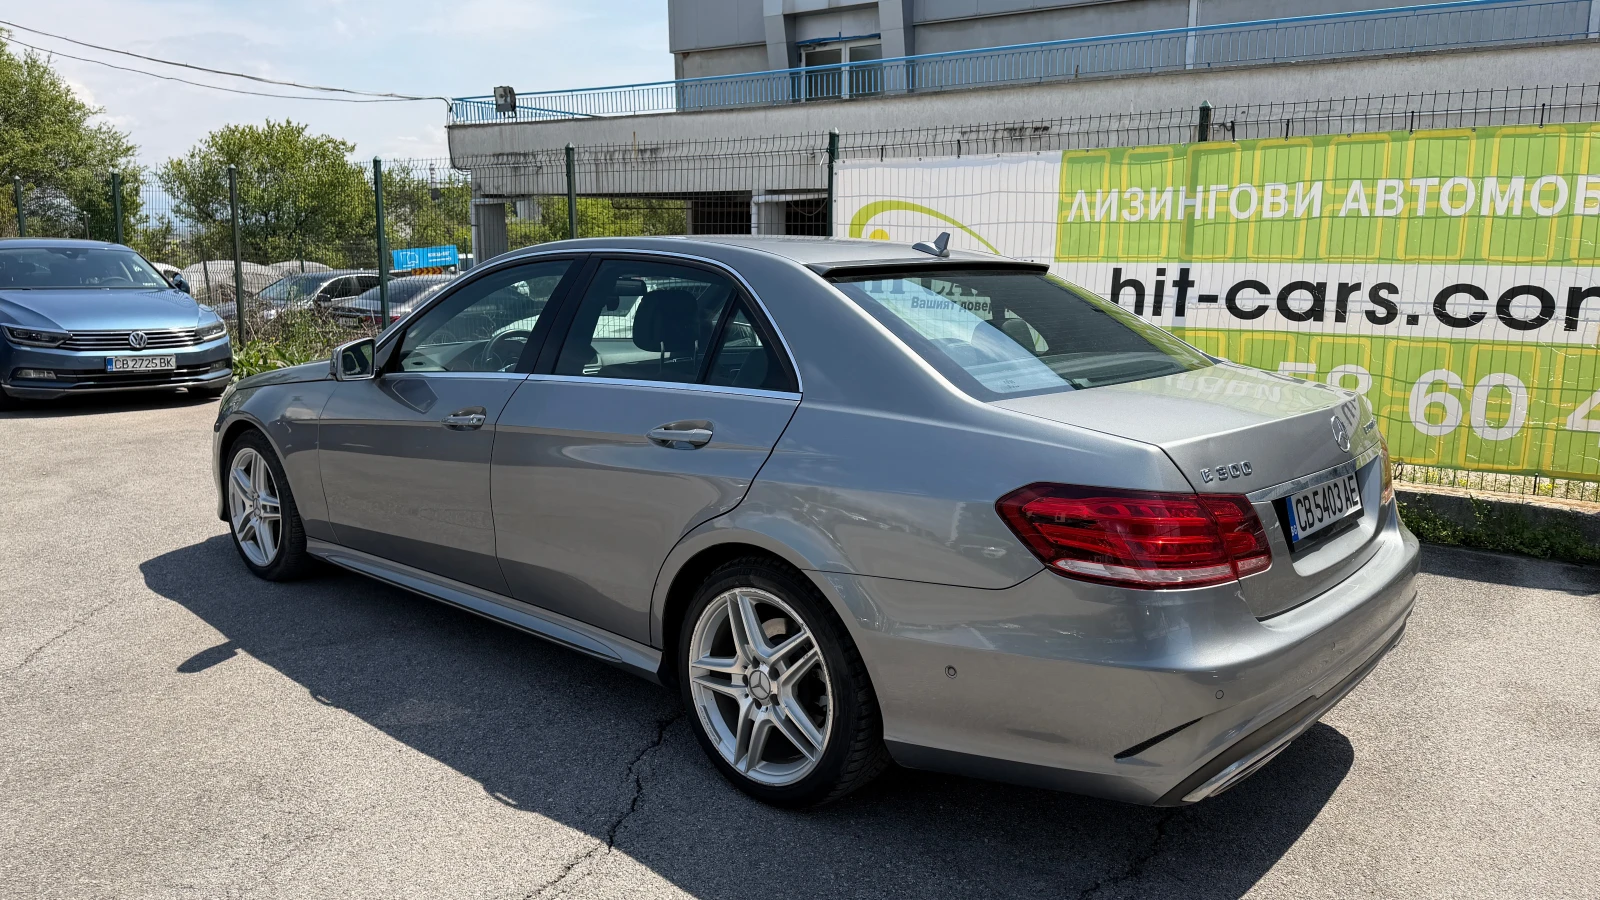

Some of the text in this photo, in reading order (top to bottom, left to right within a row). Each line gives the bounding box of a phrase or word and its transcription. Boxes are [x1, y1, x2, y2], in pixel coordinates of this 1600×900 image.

[1067, 175, 1600, 222] ЛИЗИНГОВИ АВТОМОБ
[911, 296, 955, 310] Вашият
[114, 358, 129, 369] CB
[131, 358, 158, 369] 2725
[159, 357, 174, 368] BK
[1408, 368, 1528, 441] 60
[1200, 460, 1253, 483] E 300
[1295, 474, 1359, 532] CB 5403 AE
